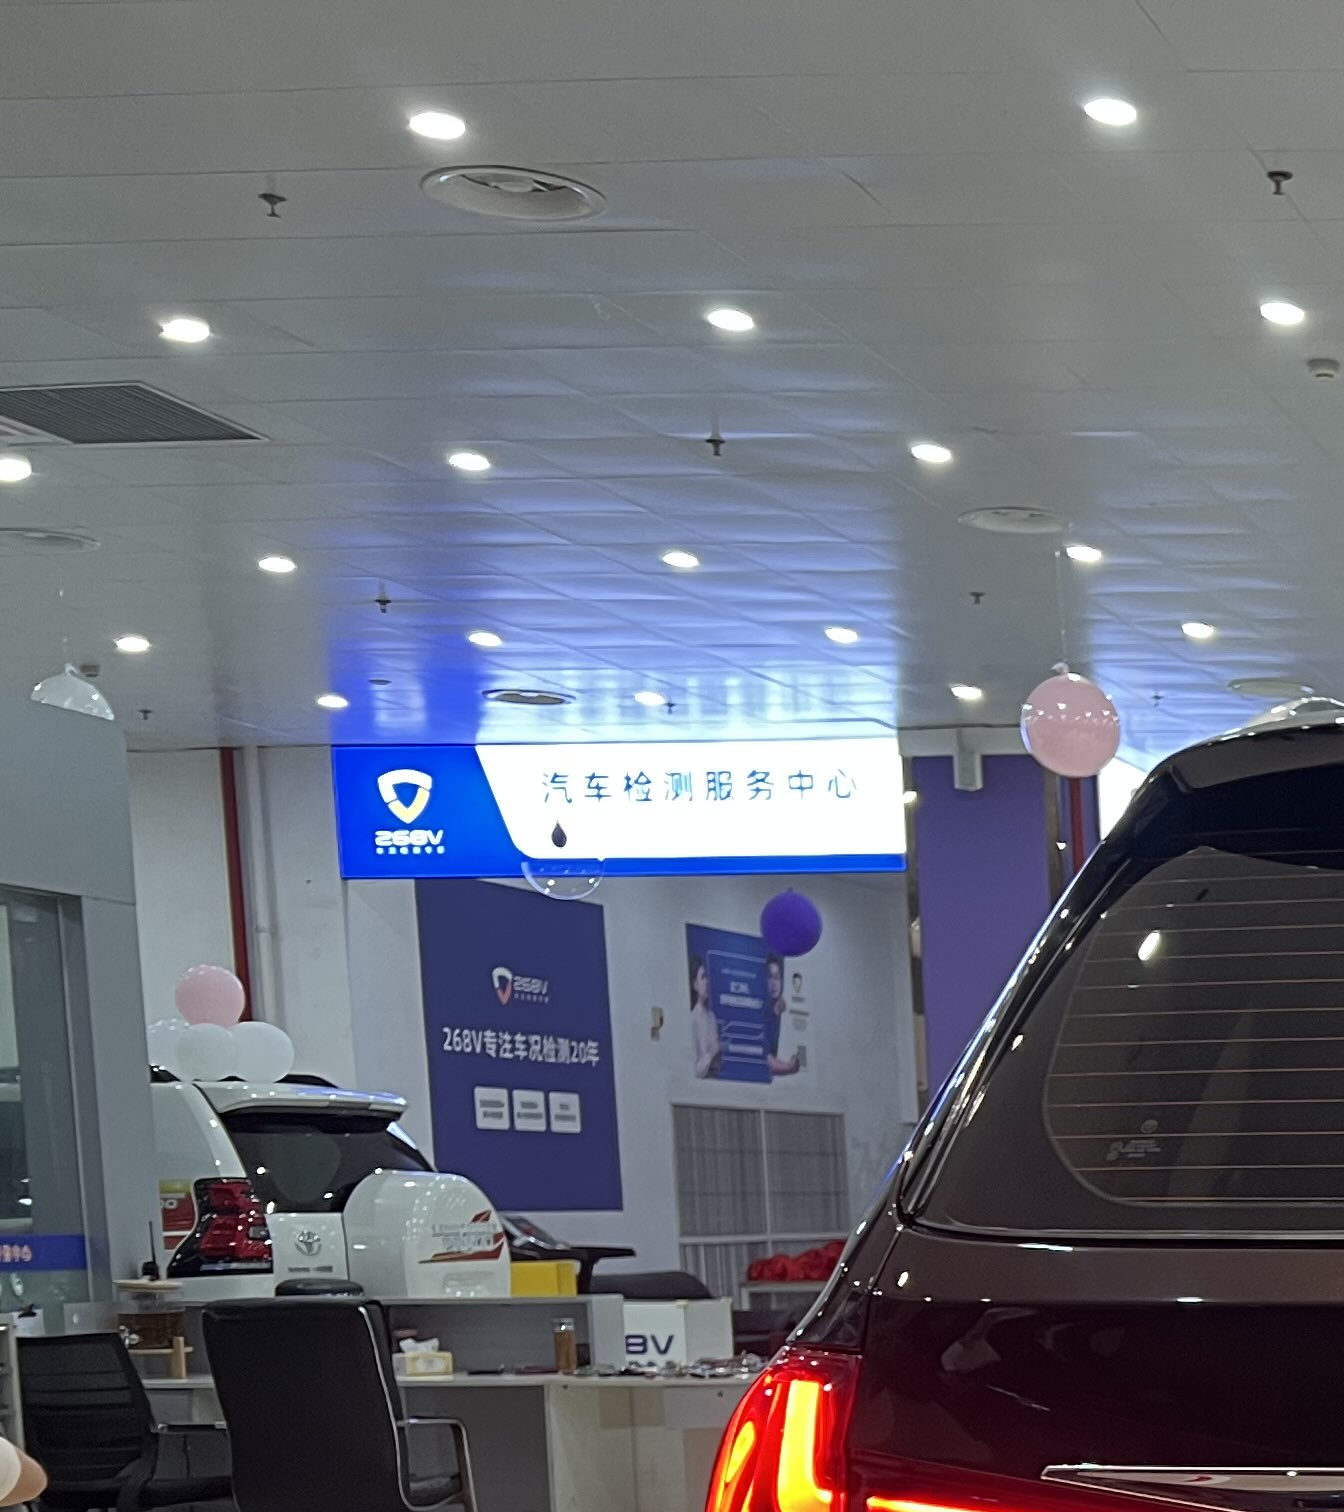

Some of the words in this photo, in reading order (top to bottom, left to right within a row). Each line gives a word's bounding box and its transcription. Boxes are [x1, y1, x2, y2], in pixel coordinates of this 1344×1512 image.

[542, 768, 857, 803] 汽车检测服务中心
[375, 829, 444, 846] 268V
[443, 1027, 600, 1067] 268V专注车况检测20年
